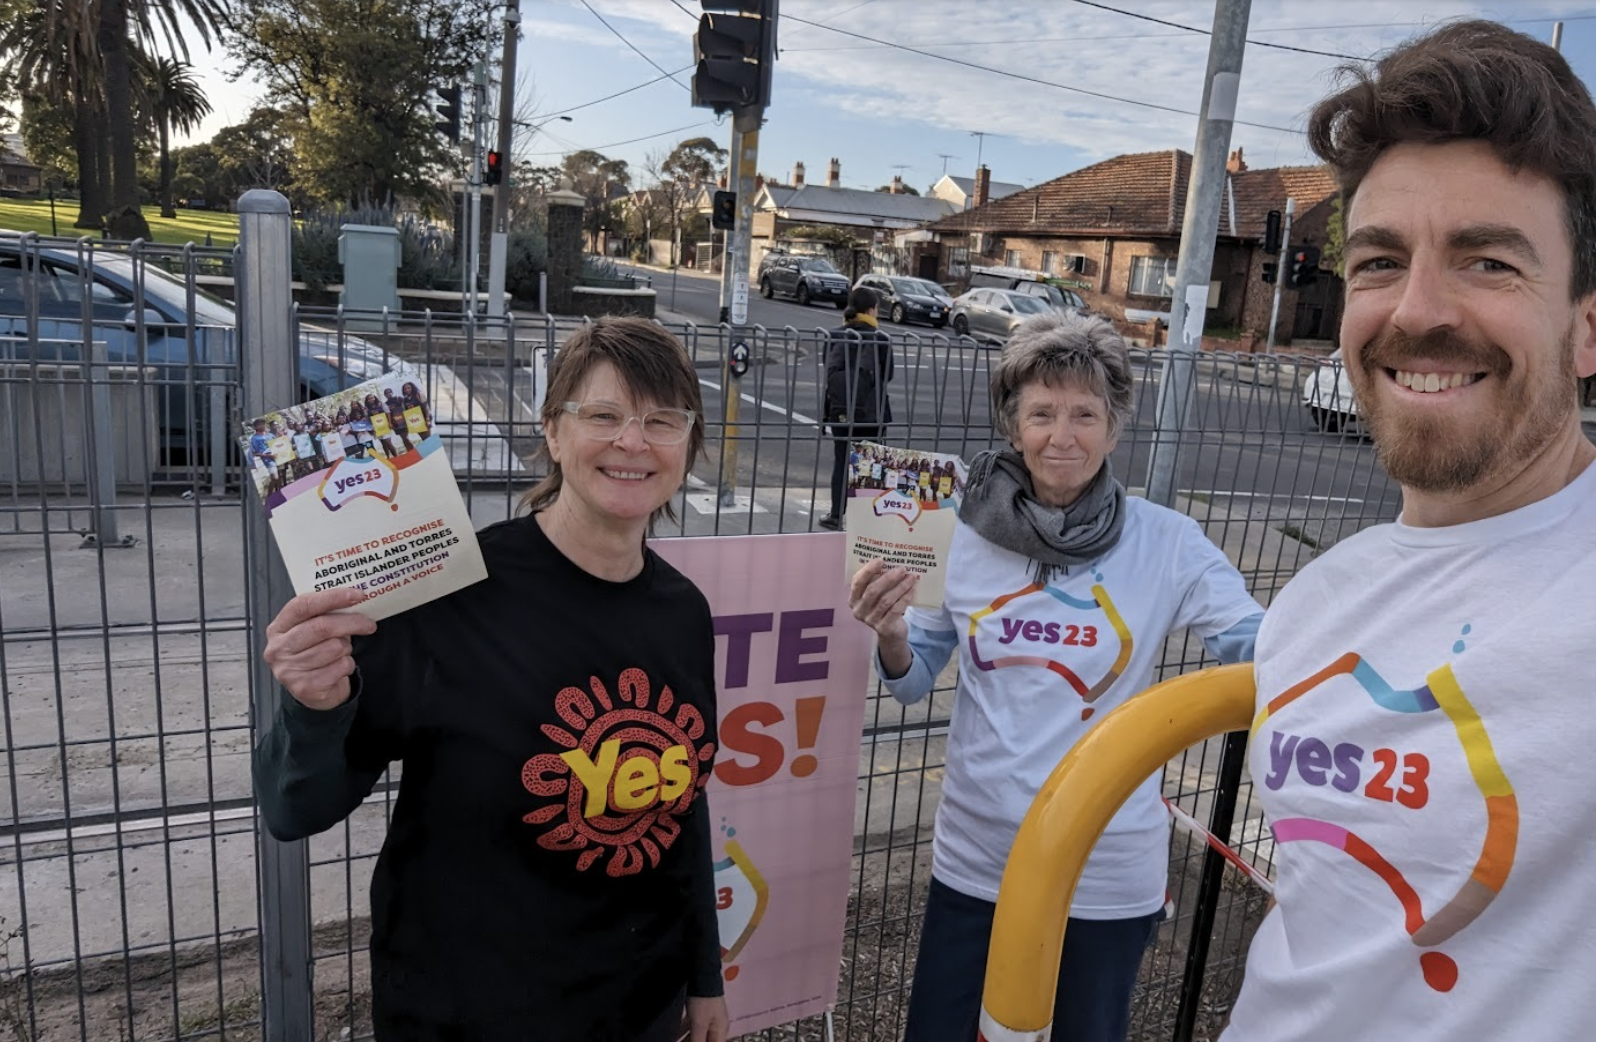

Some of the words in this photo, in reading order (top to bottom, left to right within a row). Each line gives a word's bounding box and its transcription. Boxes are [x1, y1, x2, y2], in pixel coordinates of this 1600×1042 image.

[334, 468, 382, 494] yes23
[883, 500, 912, 510] yes23
[314, 554, 335, 567] IT'S
[335, 547, 363, 559] TIME
[363, 540, 380, 551] TO
[382, 518, 445, 545] RECOGNISE
[314, 552, 383, 580] ABORIGINAL
[384, 544, 407, 558] AND
[408, 528, 453, 549] TORRES
[853, 549, 872, 559] STRAIT
[906, 559, 937, 567] PEOPLES
[854, 542, 891, 556] ABORIGINAL
[908, 551, 936, 560] TORRES
[868, 538, 883, 547] TIME
[894, 543, 934, 552] RECOGNISE
[314, 573, 353, 592] STRAIT
[355, 555, 411, 580] ISLANDER
[412, 536, 460, 560] PEOPLES
[360, 581, 401, 604] ROUGH
[403, 577, 411, 586] A
[411, 563, 444, 581] VOICE
[370, 551, 450, 587] CONSTITUTION
[711, 608, 835, 690] TE
[998, 617, 1098, 647] yes23
[713, 695, 826, 787] S!
[559, 738, 692, 819] Yes
[1265, 730, 1430, 810] yes23
